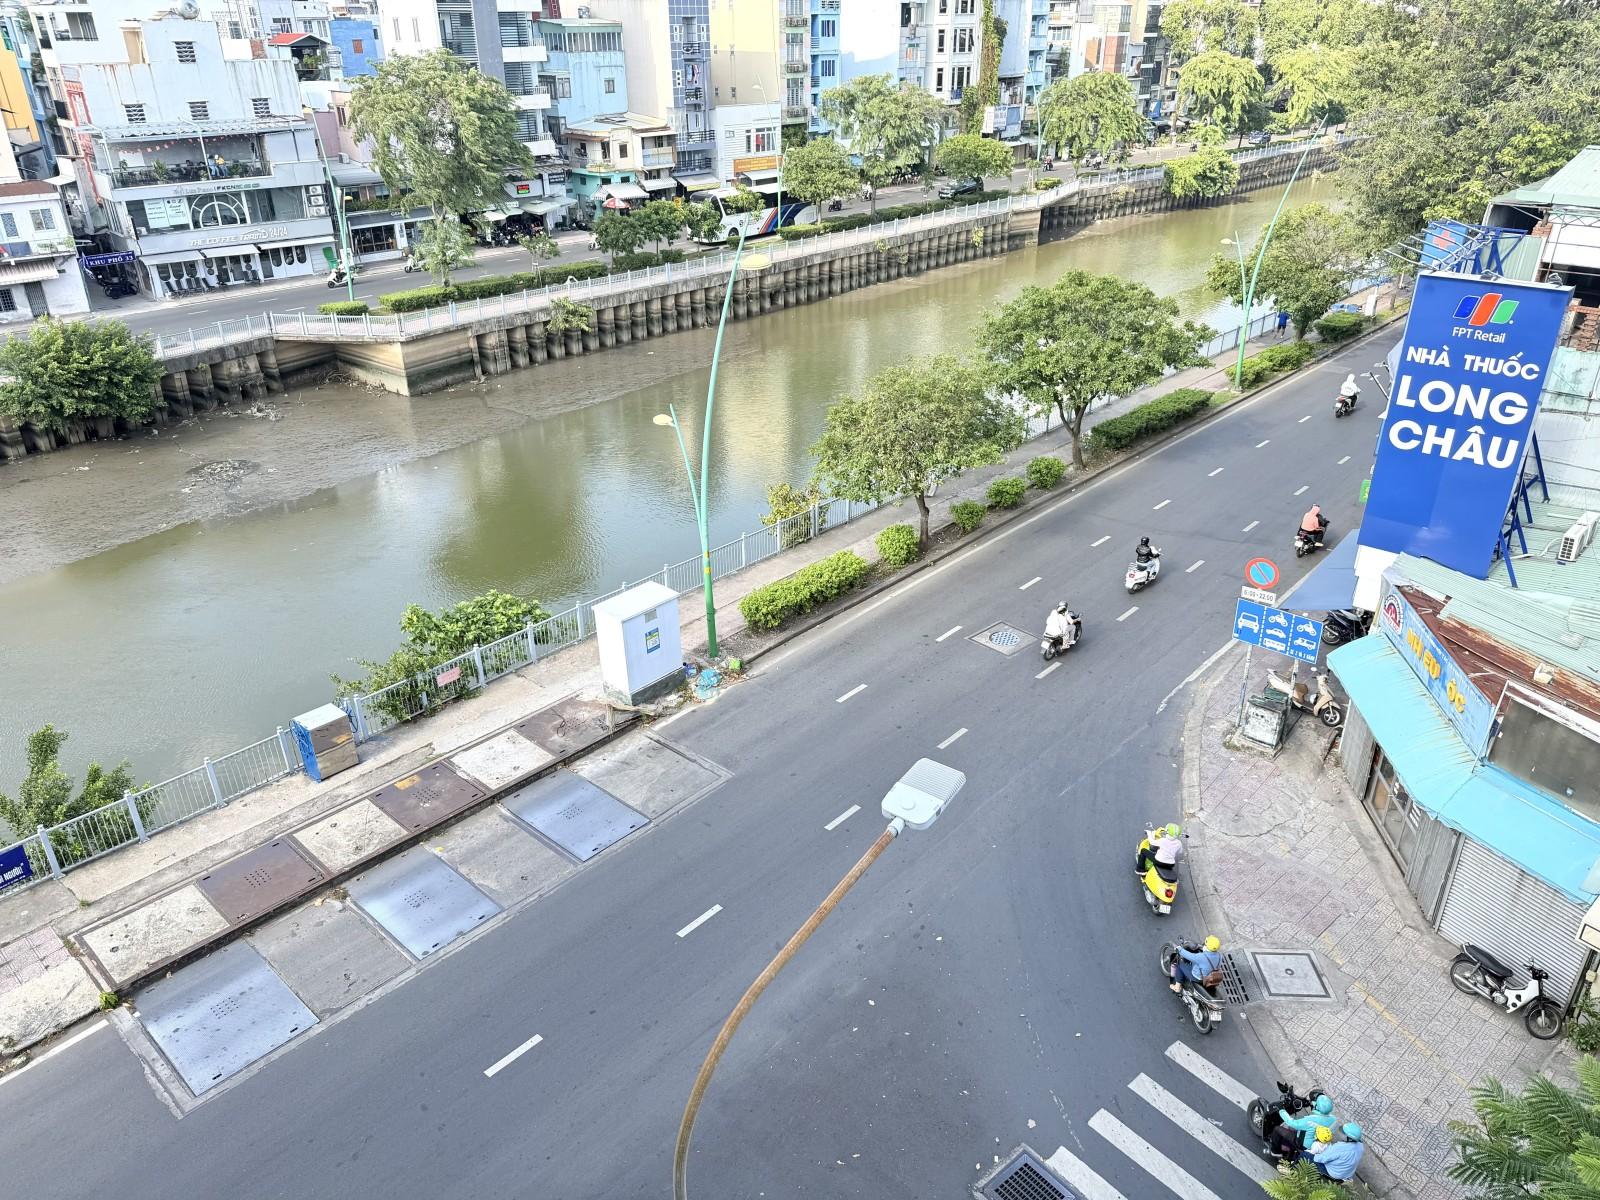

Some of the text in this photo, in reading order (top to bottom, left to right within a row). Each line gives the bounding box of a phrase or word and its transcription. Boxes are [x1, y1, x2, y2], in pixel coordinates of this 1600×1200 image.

[1452, 327, 1506, 344] FPT Retail
[1406, 344, 1540, 380] NHÀ THUỐC
[1396, 375, 1529, 425] LONG
[1389, 420, 1519, 469] CHÂU
